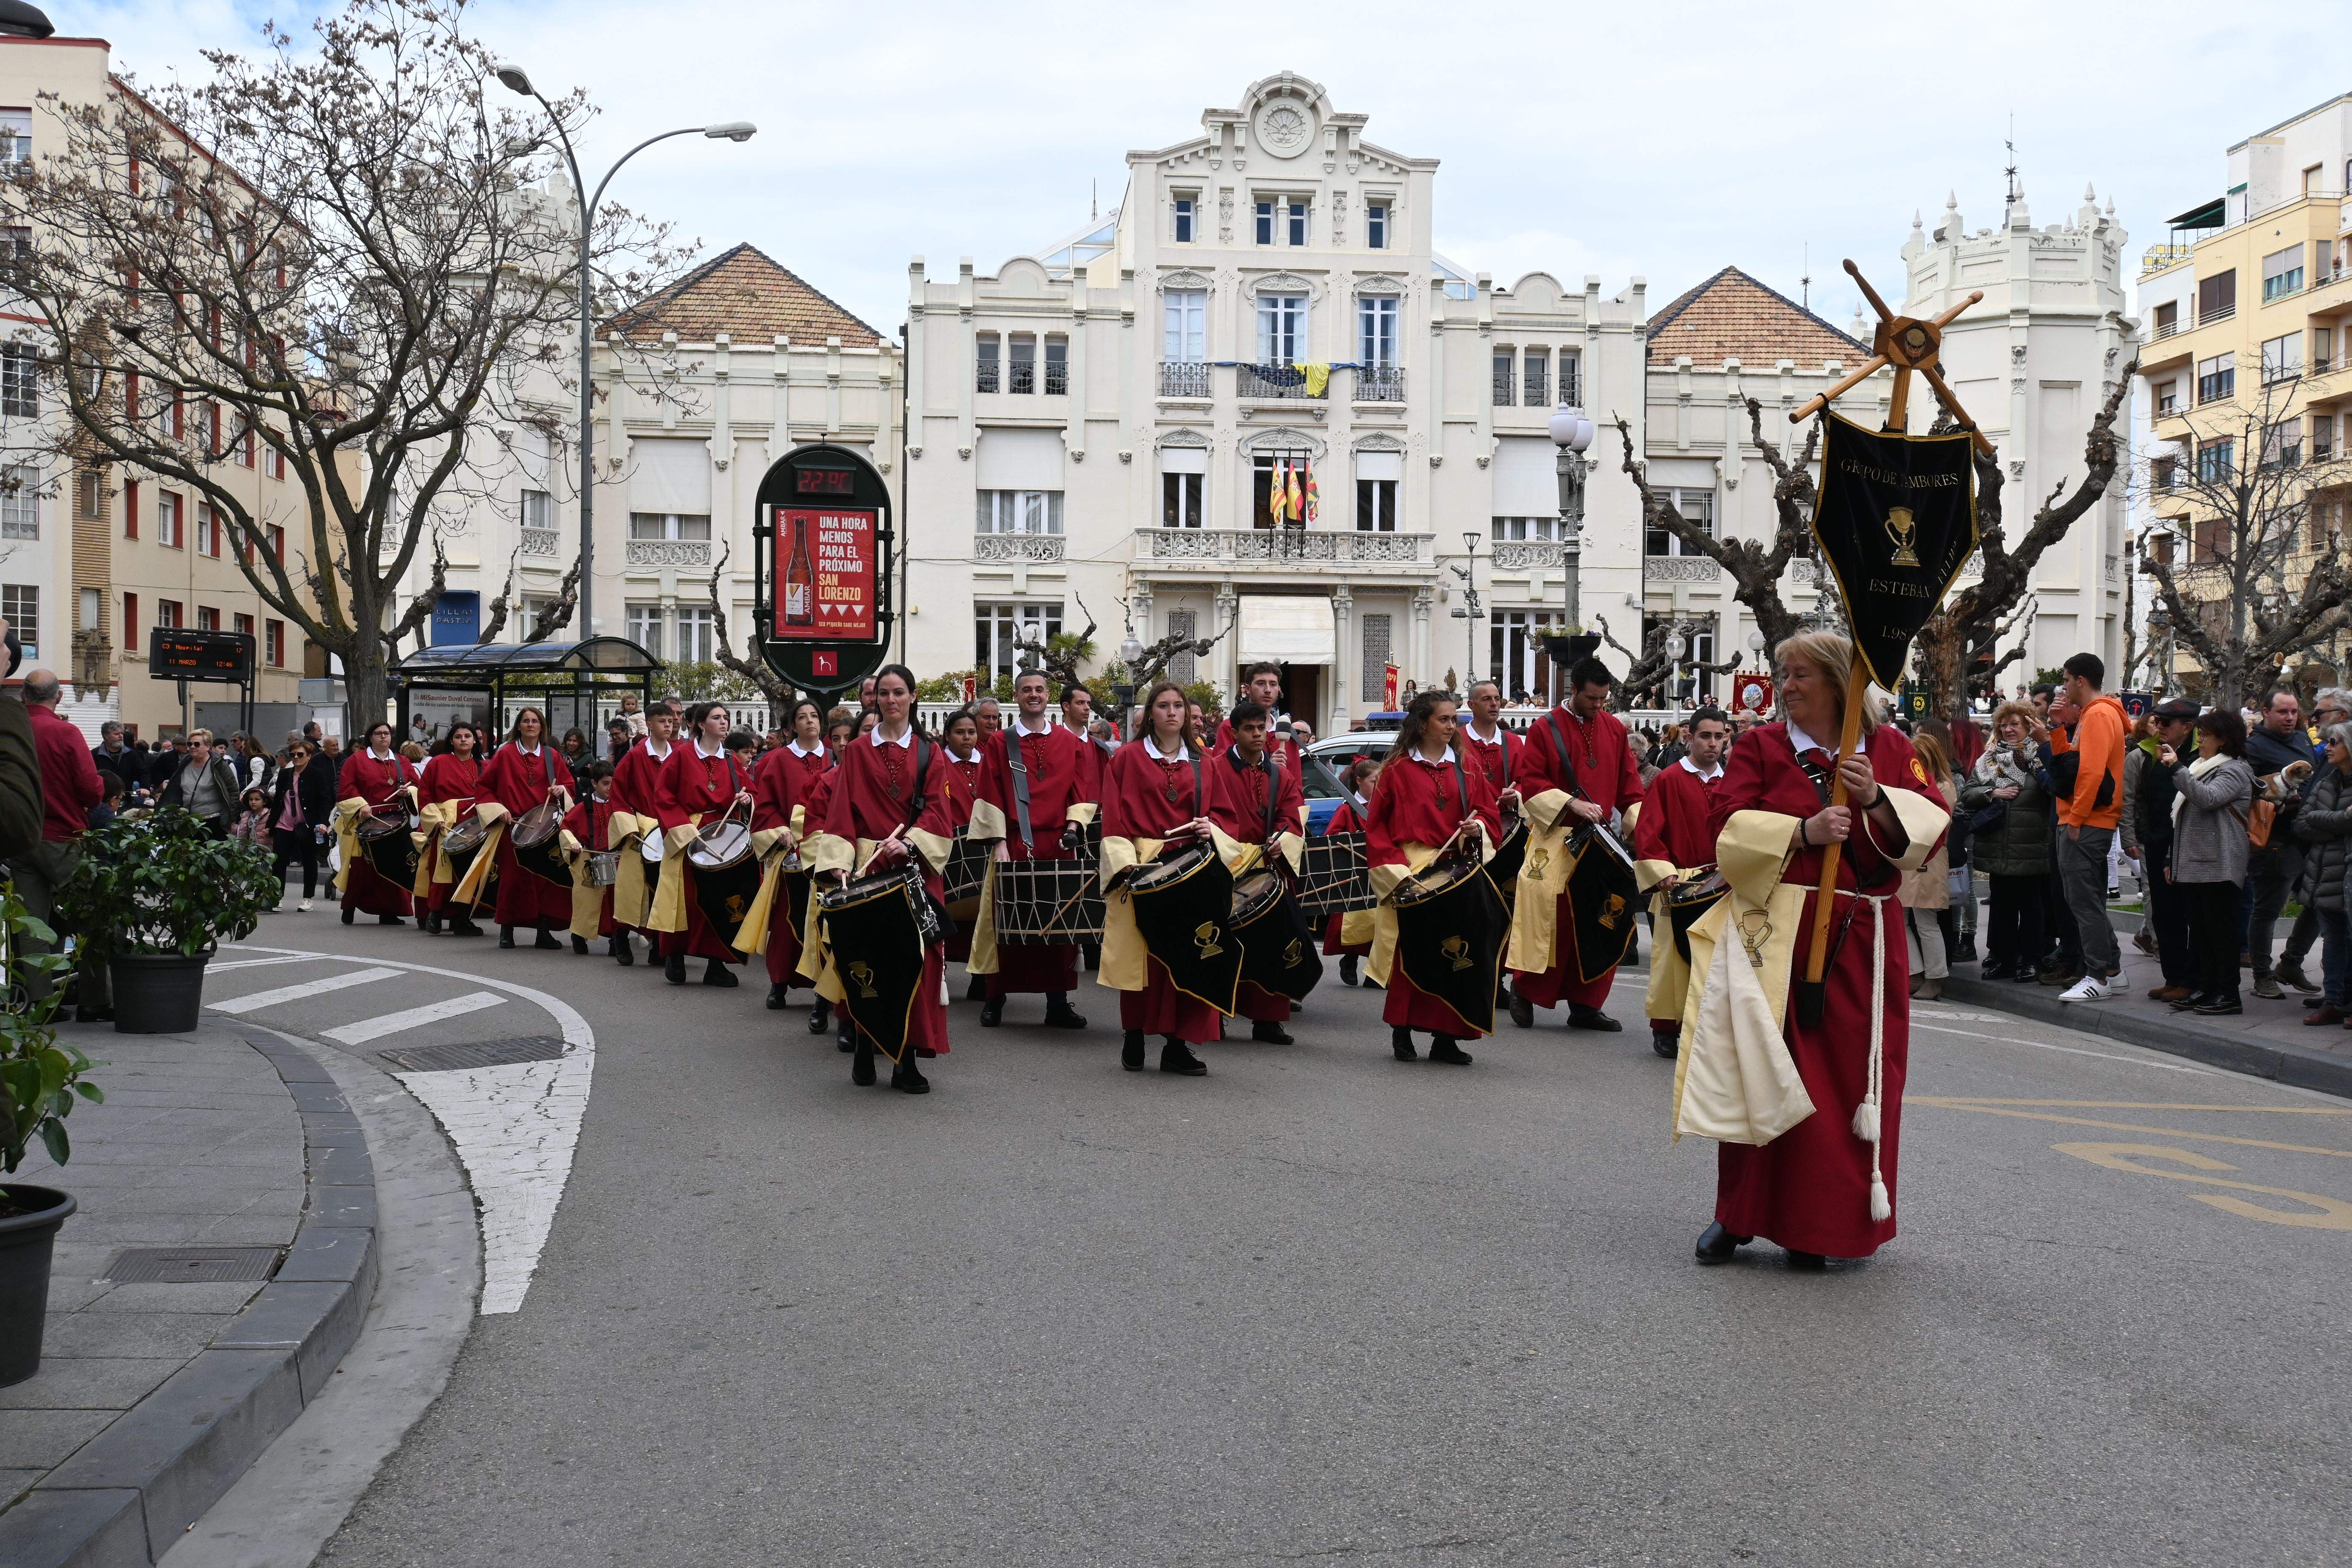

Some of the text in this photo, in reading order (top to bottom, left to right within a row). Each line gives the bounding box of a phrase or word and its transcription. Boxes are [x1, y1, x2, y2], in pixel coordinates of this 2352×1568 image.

[1882, 470, 1897, 485] DE
[1900, 473, 1958, 488] MBORES
[819, 516, 867, 530] UNA HORA
[819, 531, 853, 544] MENOS
[819, 545, 858, 558] PARA EL
[819, 558, 863, 572] PRÓXIMO
[819, 574, 838, 585] SAN
[819, 586, 861, 601] LORENZO
